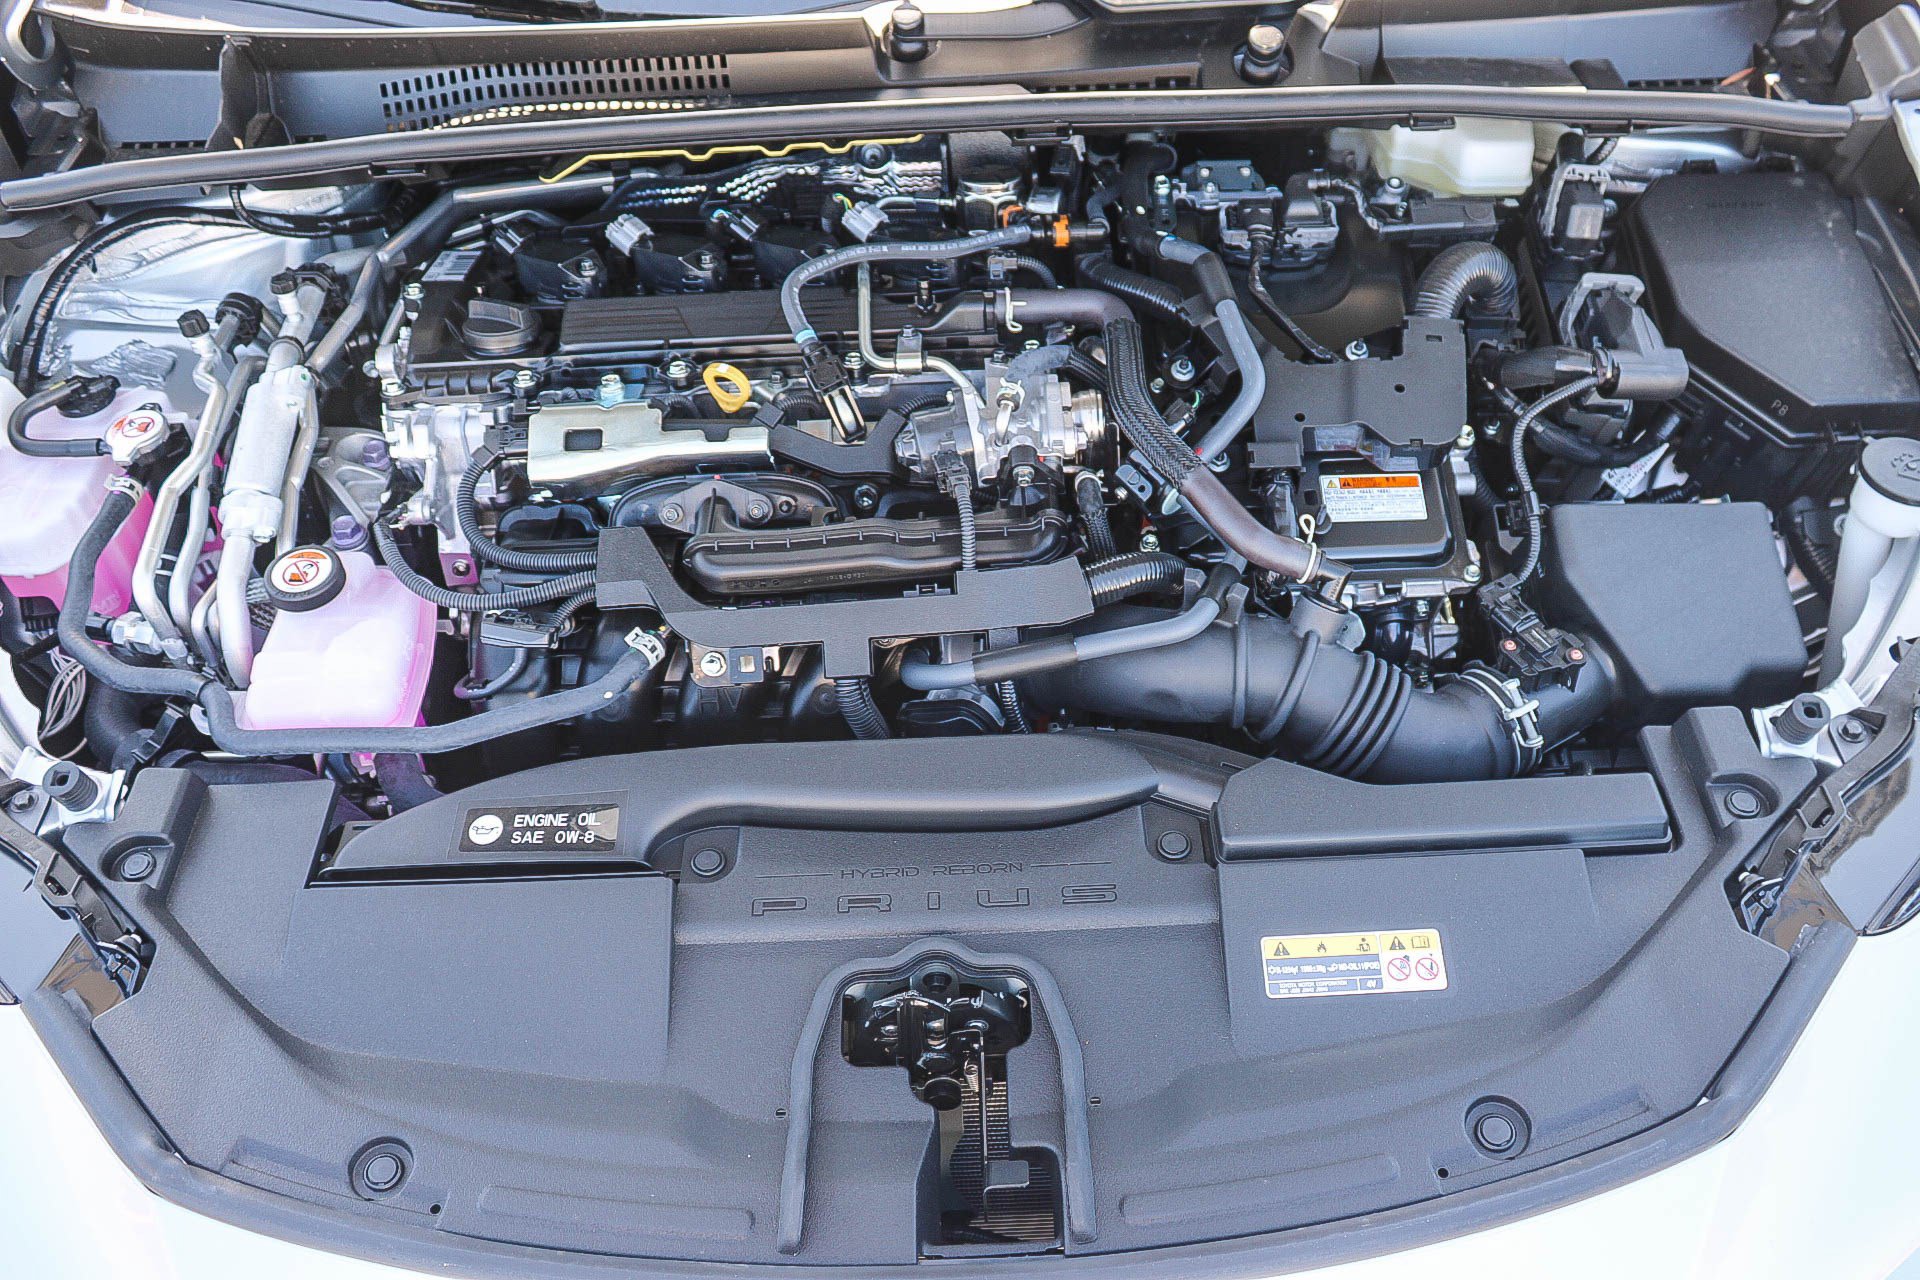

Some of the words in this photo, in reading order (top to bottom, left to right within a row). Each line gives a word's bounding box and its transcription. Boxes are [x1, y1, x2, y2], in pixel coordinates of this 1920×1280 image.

[1771, 399, 1789, 416] P8
[697, 686, 744, 717] HV
[513, 813, 569, 828] ENGINE
[577, 812, 601, 826] OIL
[510, 830, 545, 844] SAE
[554, 830, 595, 844] 0W-8
[840, 866, 920, 880] HYBRID
[932, 861, 1024, 876] REBORN
[752, 884, 1118, 917] PRIUS
